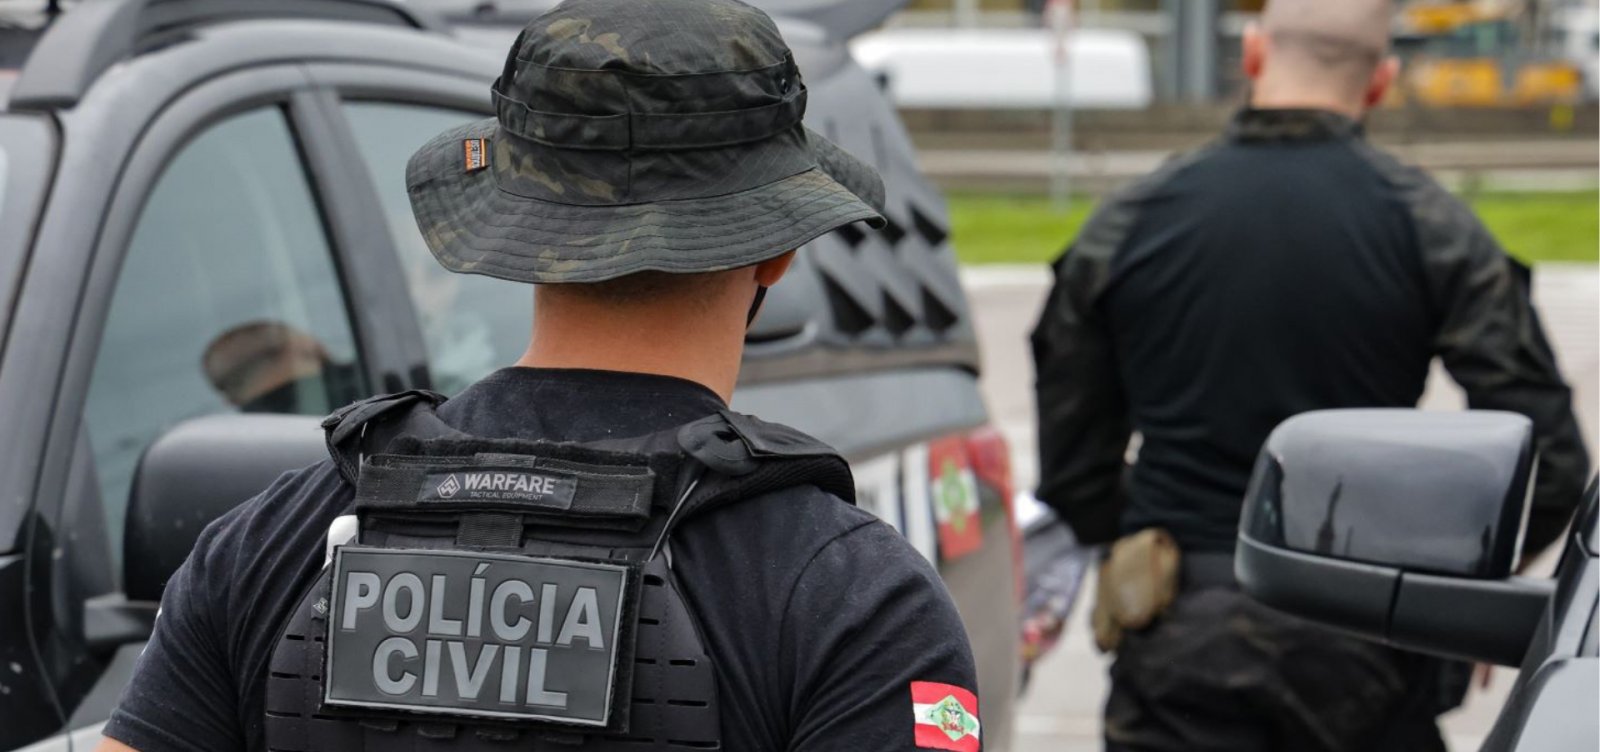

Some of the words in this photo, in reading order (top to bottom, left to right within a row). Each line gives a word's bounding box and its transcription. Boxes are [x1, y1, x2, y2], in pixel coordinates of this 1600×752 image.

[464, 473, 556, 495] WARFARE
[470, 491, 499, 499] TACTICAL
[502, 491, 543, 501] EQUIPMENT
[341, 563, 605, 650] POLÍCIA
[372, 638, 568, 707] CIVIL
